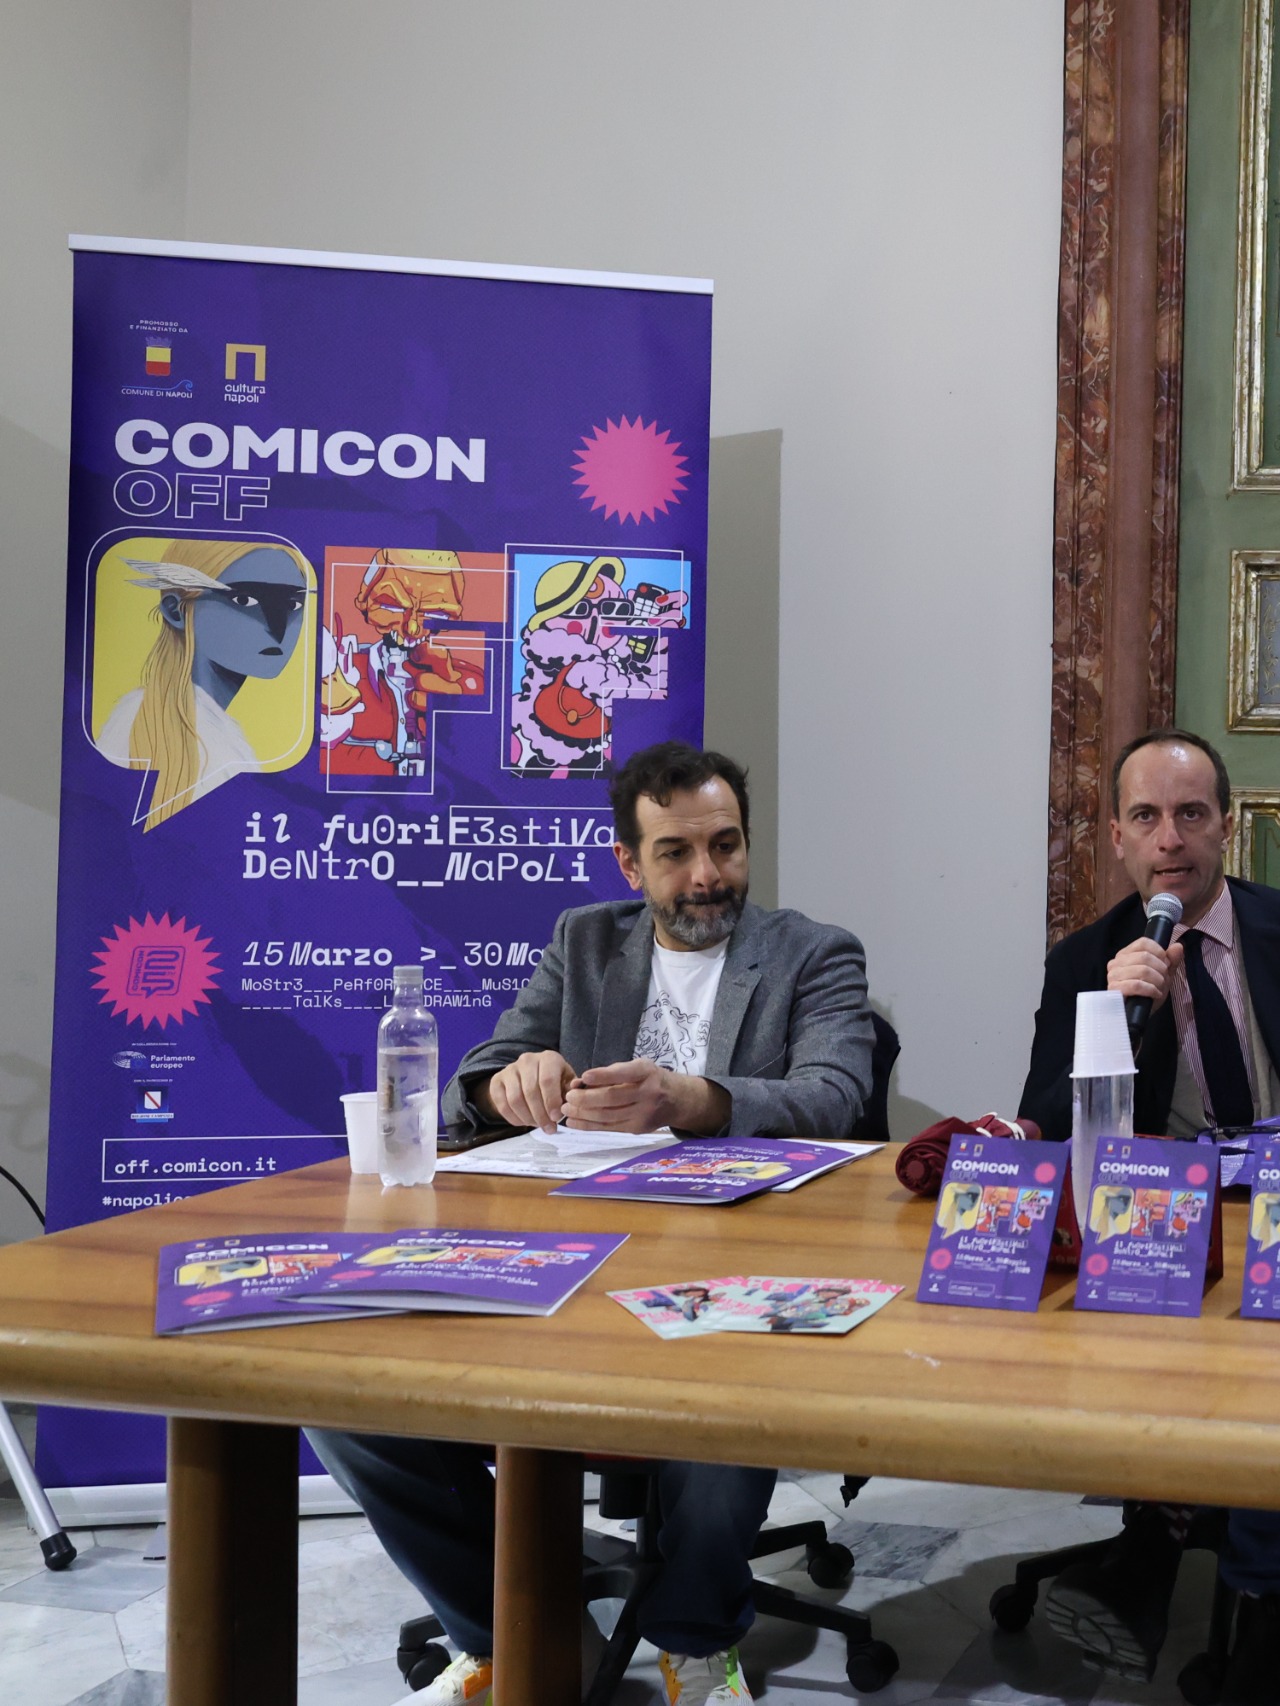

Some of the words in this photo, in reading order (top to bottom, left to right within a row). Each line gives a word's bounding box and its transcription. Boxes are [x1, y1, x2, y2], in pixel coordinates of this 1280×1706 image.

[139, 319, 179, 327] PROMOSSO
[121, 388, 154, 397] COMUNE
[166, 391, 193, 399] NAPOLI
[224, 383, 266, 394] cultura
[224, 393, 259, 404] napoli
[115, 418, 486, 483] COMICON
[113, 469, 270, 521] OFF
[114, 1158, 277, 1175] off.comicon.it
[951, 1159, 1019, 1176] COMICON
[1100, 1161, 1170, 1177] COMICON
